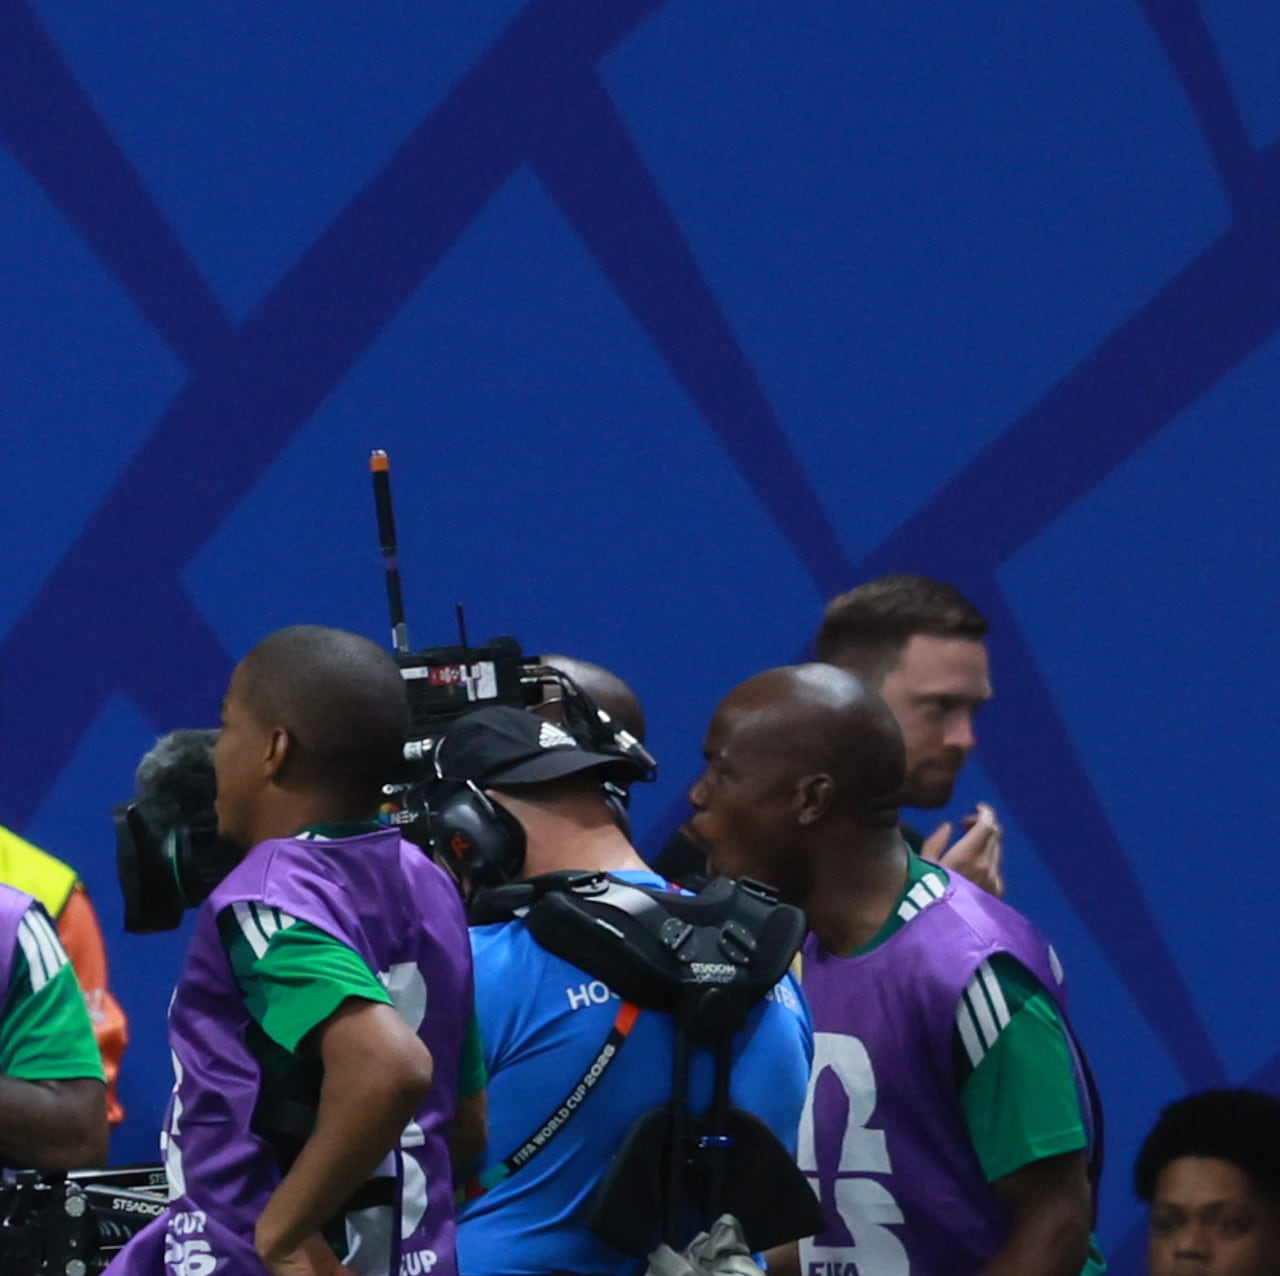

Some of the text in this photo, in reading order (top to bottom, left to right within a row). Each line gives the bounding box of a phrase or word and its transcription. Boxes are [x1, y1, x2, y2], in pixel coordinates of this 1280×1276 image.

[512, 1043, 616, 1166] FIFA WORLD CUP 2026
[112, 1198, 169, 1217] STEADICA
